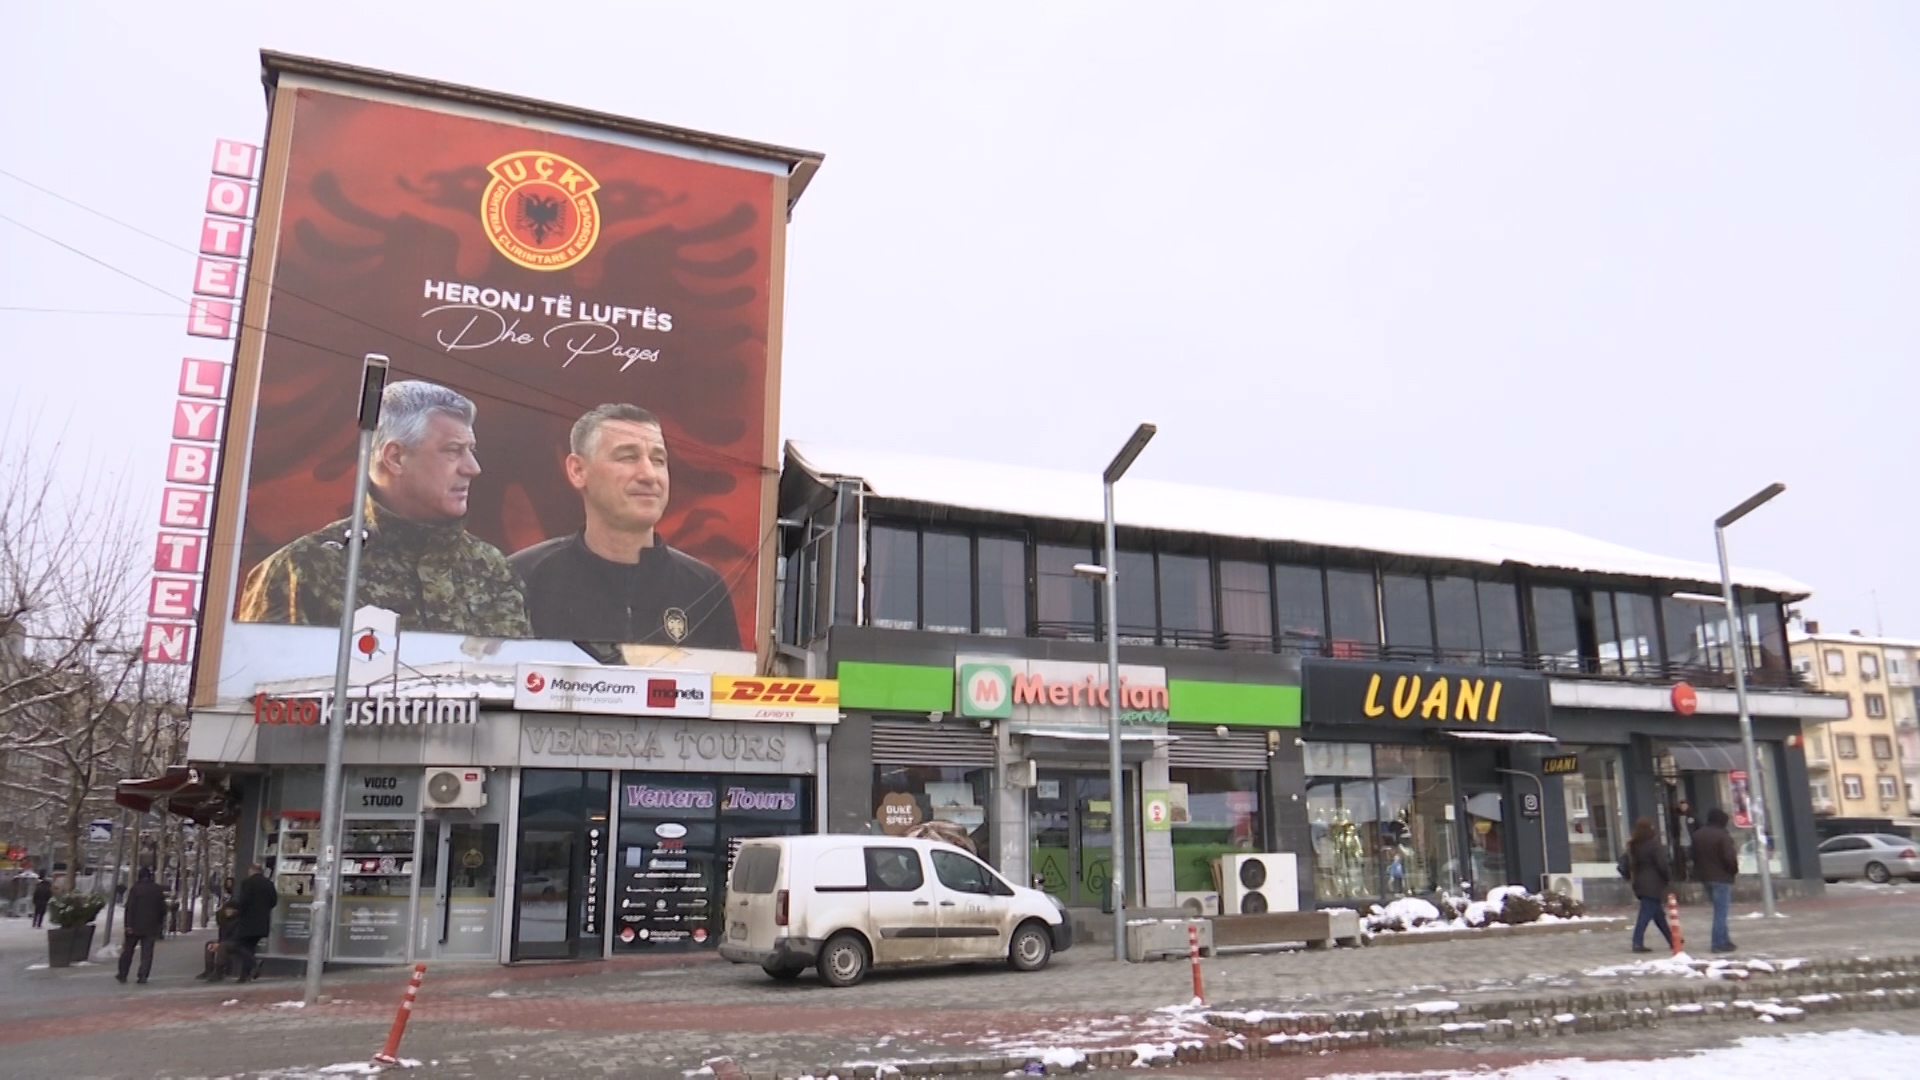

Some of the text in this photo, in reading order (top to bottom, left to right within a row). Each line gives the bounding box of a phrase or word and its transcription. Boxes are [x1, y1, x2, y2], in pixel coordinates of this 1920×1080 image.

[502, 156, 586, 193] UÇK
[192, 142, 252, 335] HOTEL
[423, 279, 673, 333] HERONJ TË LUFTËS
[421, 304, 535, 352] Dhe
[147, 360, 216, 661] LYBETEN
[550, 678, 637, 696] MoneyGram
[652, 687, 704, 701] moneta
[730, 681, 822, 704] DHL
[976, 678, 999, 702] M
[1364, 673, 1502, 722] LUANI
[755, 710, 796, 719] EXPRESS
[525, 726, 787, 762] VENERA TOURS
[1544, 757, 1577, 773] LUANI
[363, 777, 397, 789] VIDEO
[362, 795, 403, 807] STUDIO
[627, 785, 796, 810] Venera Tours
